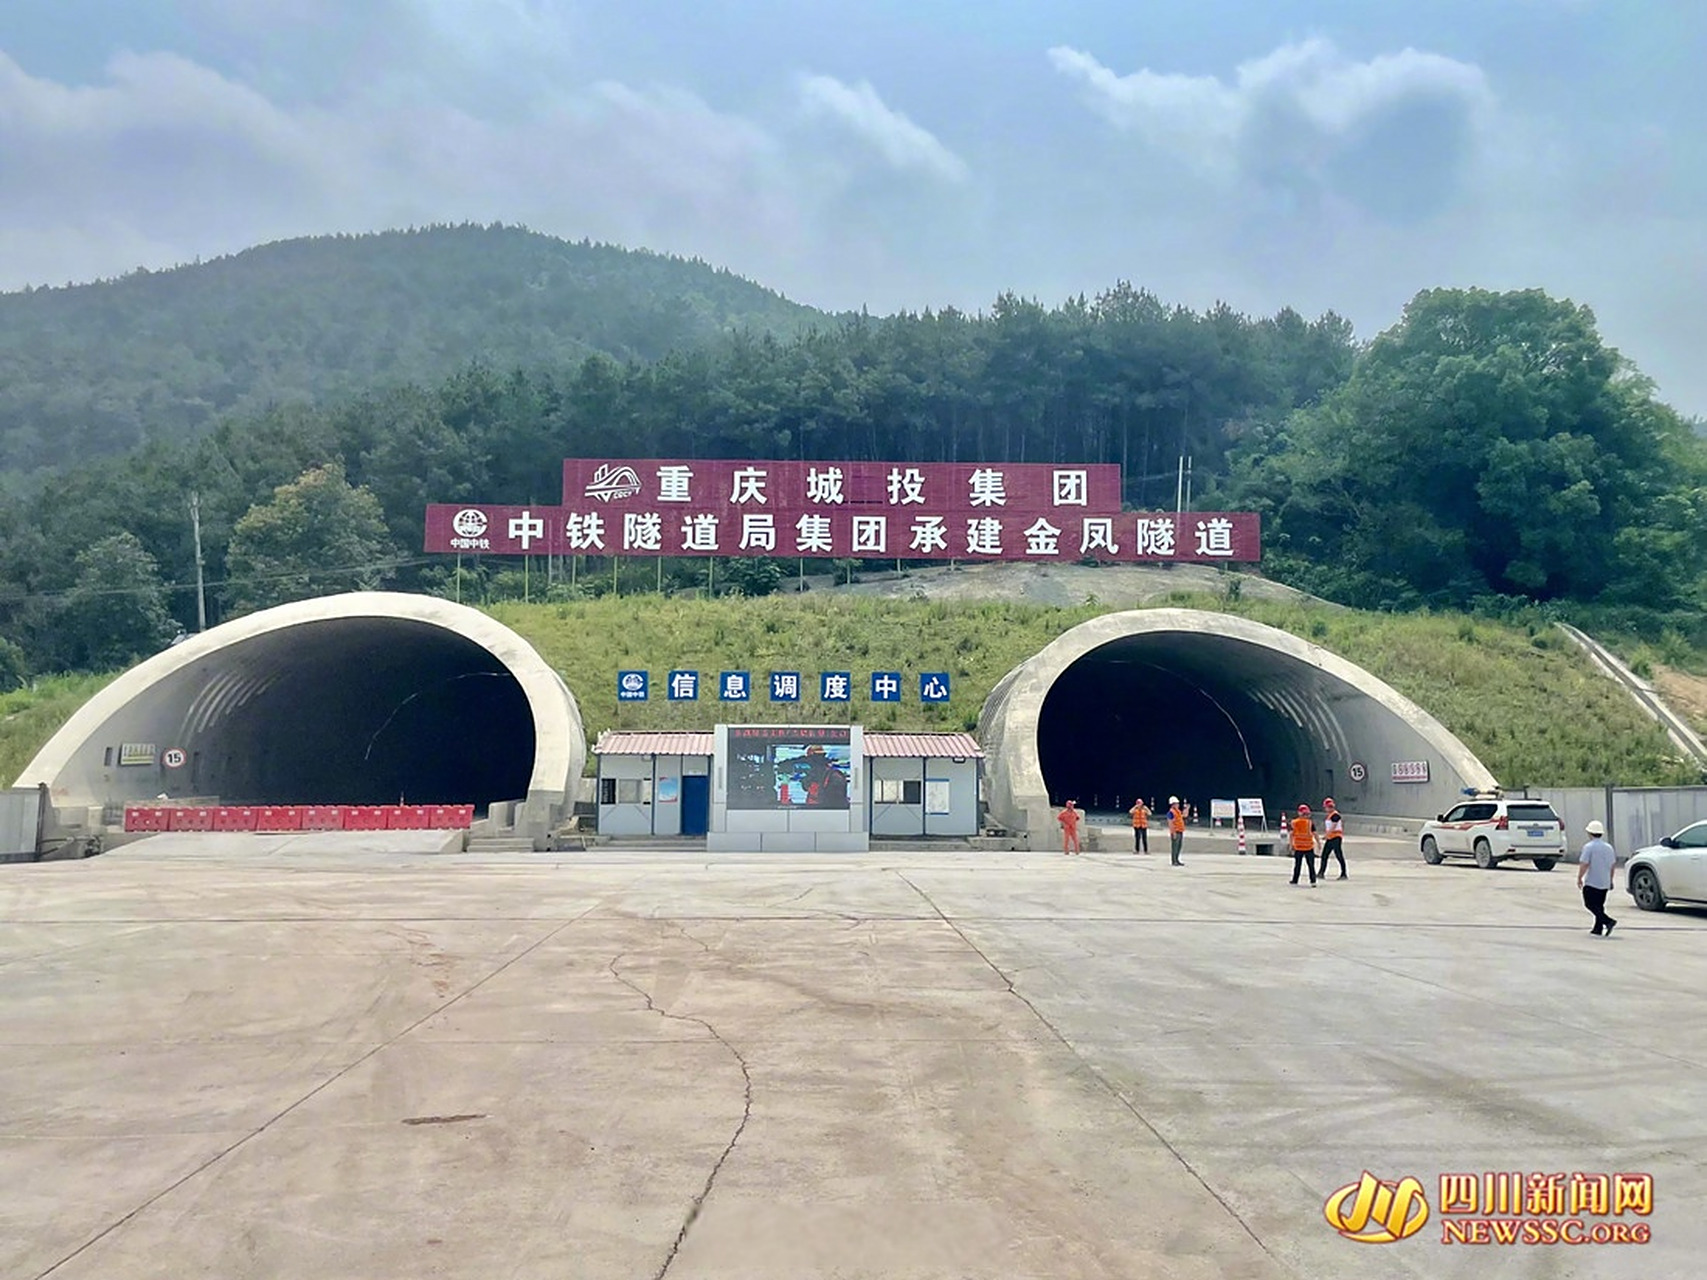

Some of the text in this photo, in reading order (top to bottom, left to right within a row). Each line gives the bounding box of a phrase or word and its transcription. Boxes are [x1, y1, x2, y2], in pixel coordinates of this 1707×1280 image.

[656, 465, 1088, 507] 重庆城投集团
[508, 511, 1234, 556] 中铁隧道局集团承建金凤隧道
[450, 537, 490, 550] 中国中铁
[671, 673, 947, 699] 信息调度中心
[167, 753, 182, 764] 15
[1352, 766, 1364, 778] 15
